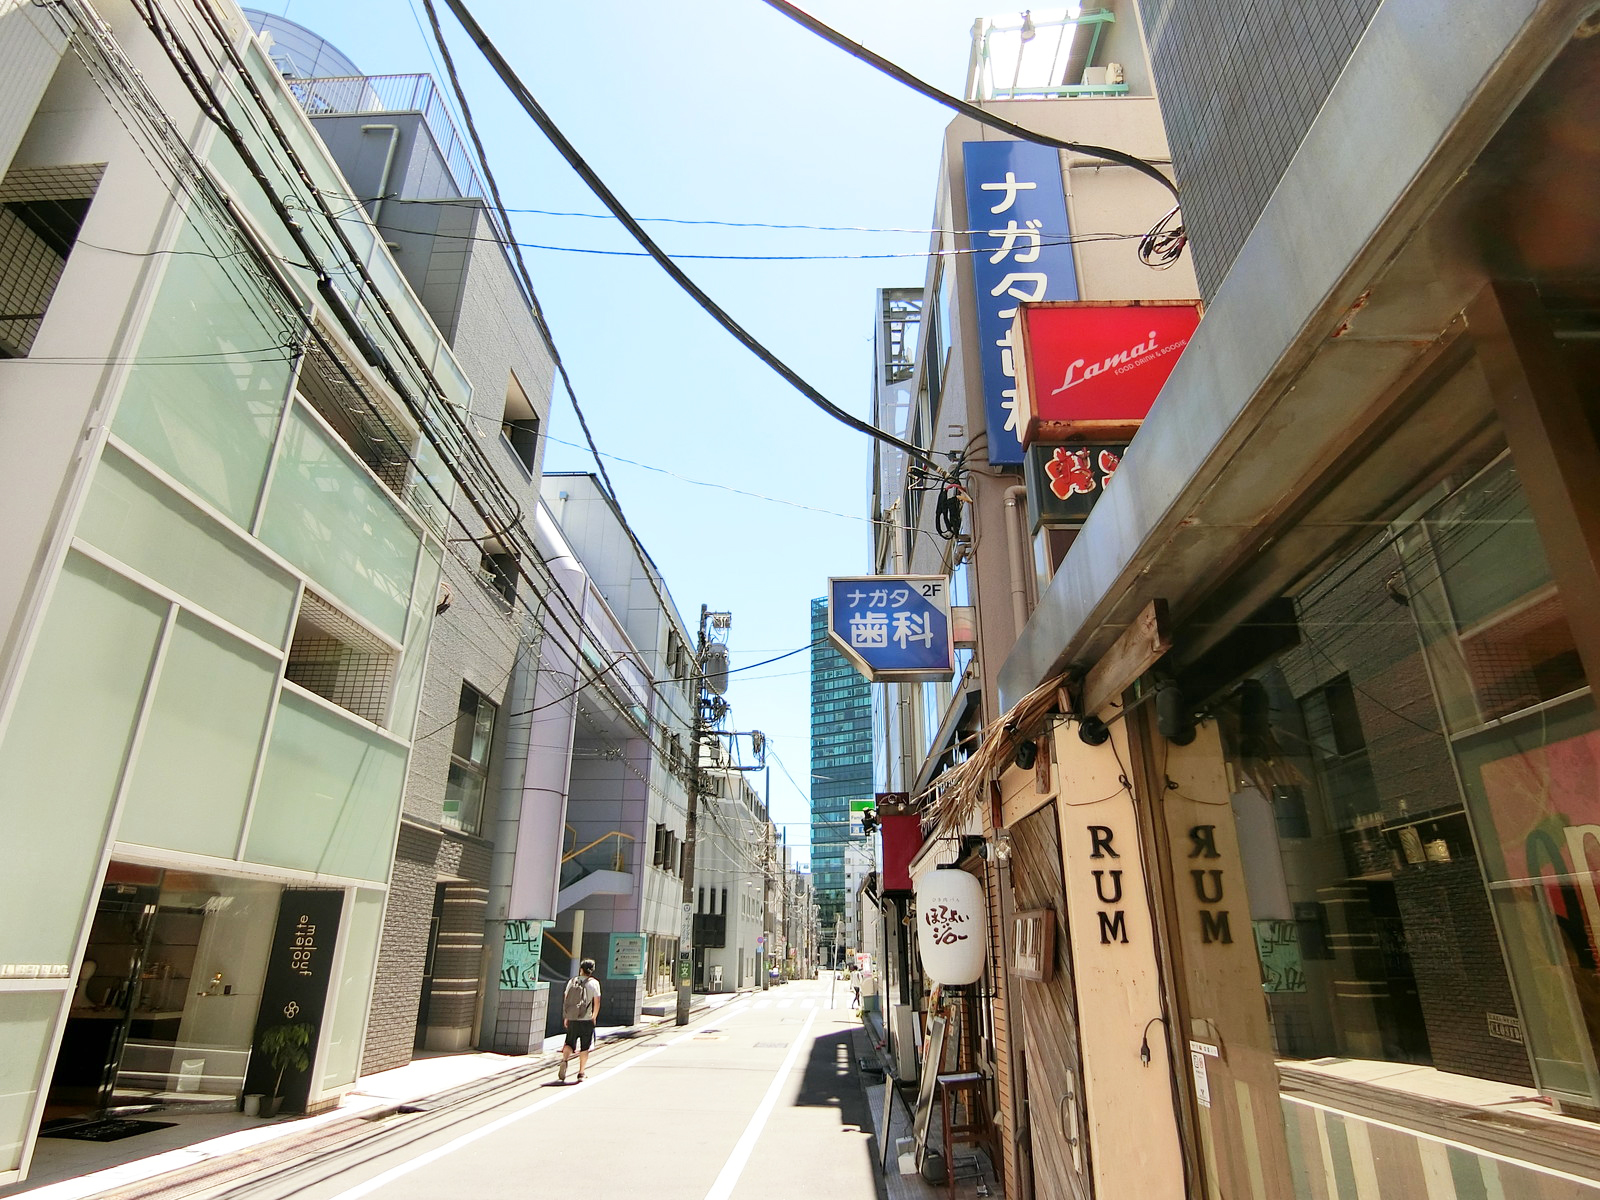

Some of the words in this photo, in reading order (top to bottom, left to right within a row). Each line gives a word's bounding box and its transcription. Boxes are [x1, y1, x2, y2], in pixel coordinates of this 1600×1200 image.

[1051, 330, 1158, 396] Lamai
[847, 589, 909, 608] ナガタ
[922, 584, 942, 597] 2F
[849, 611, 933, 649] 歯科
[1087, 825, 1130, 944] RUM
[925, 905, 970, 926] ほろよい
[289, 914, 309, 969] colette
